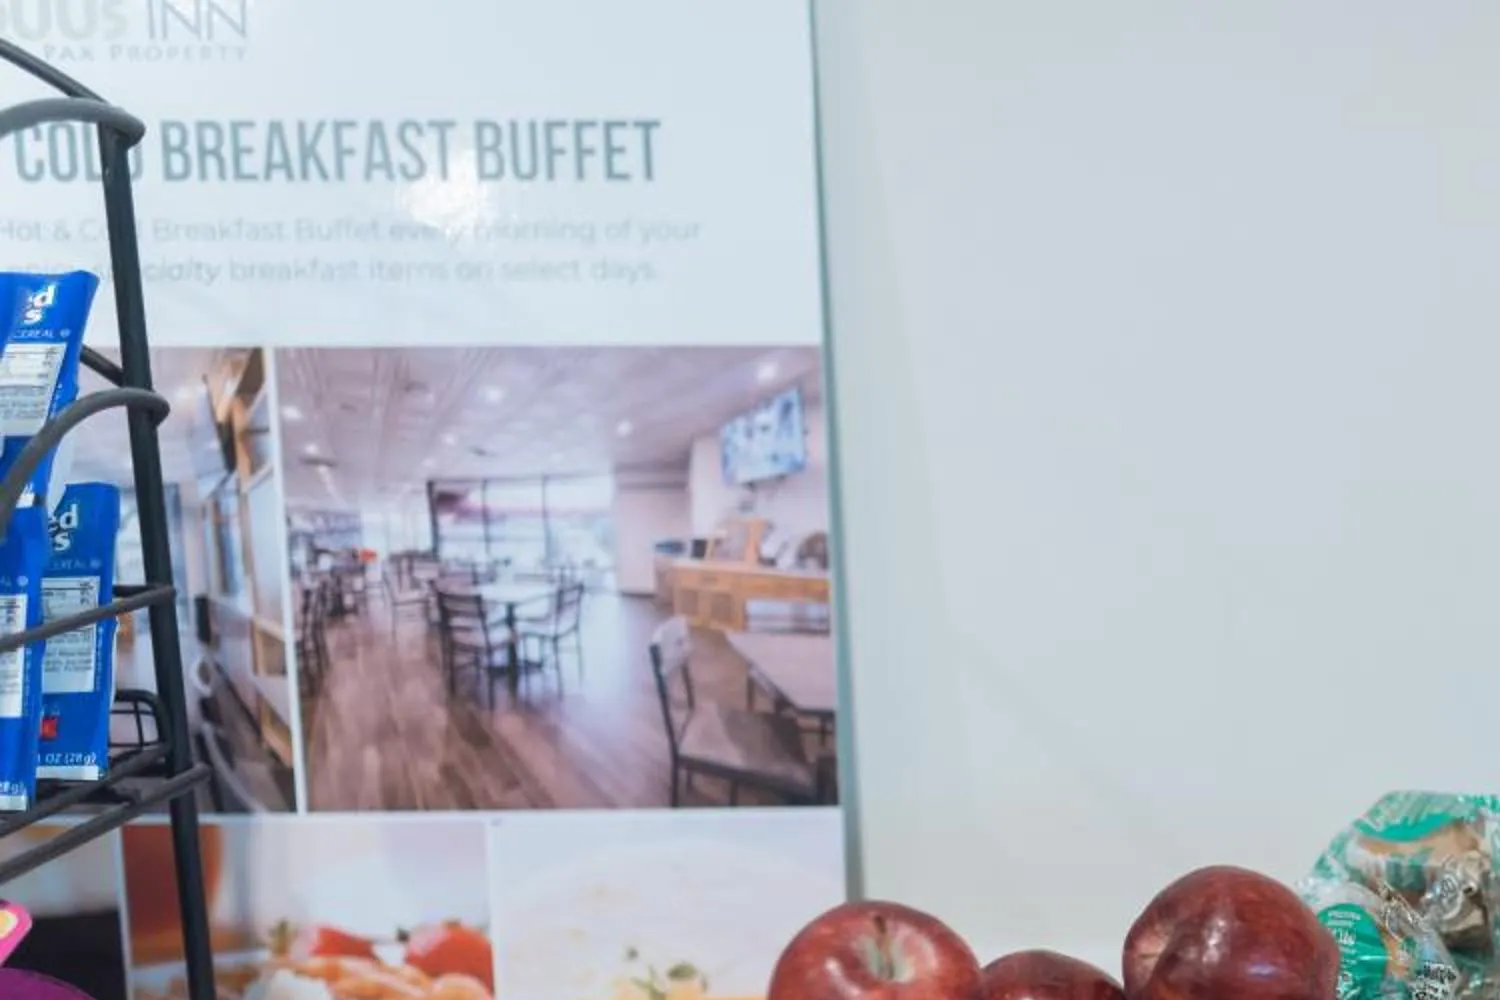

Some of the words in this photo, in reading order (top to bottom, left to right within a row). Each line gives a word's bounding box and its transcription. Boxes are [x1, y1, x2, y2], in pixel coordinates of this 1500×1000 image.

[148, 0, 248, 40] INN
[161, 119, 456, 182] BREAKFAST
[476, 118, 662, 182] BUFFET
[152, 216, 284, 243] Breakfast
[295, 216, 381, 243] Buffet
[229, 253, 361, 282] breakfast
